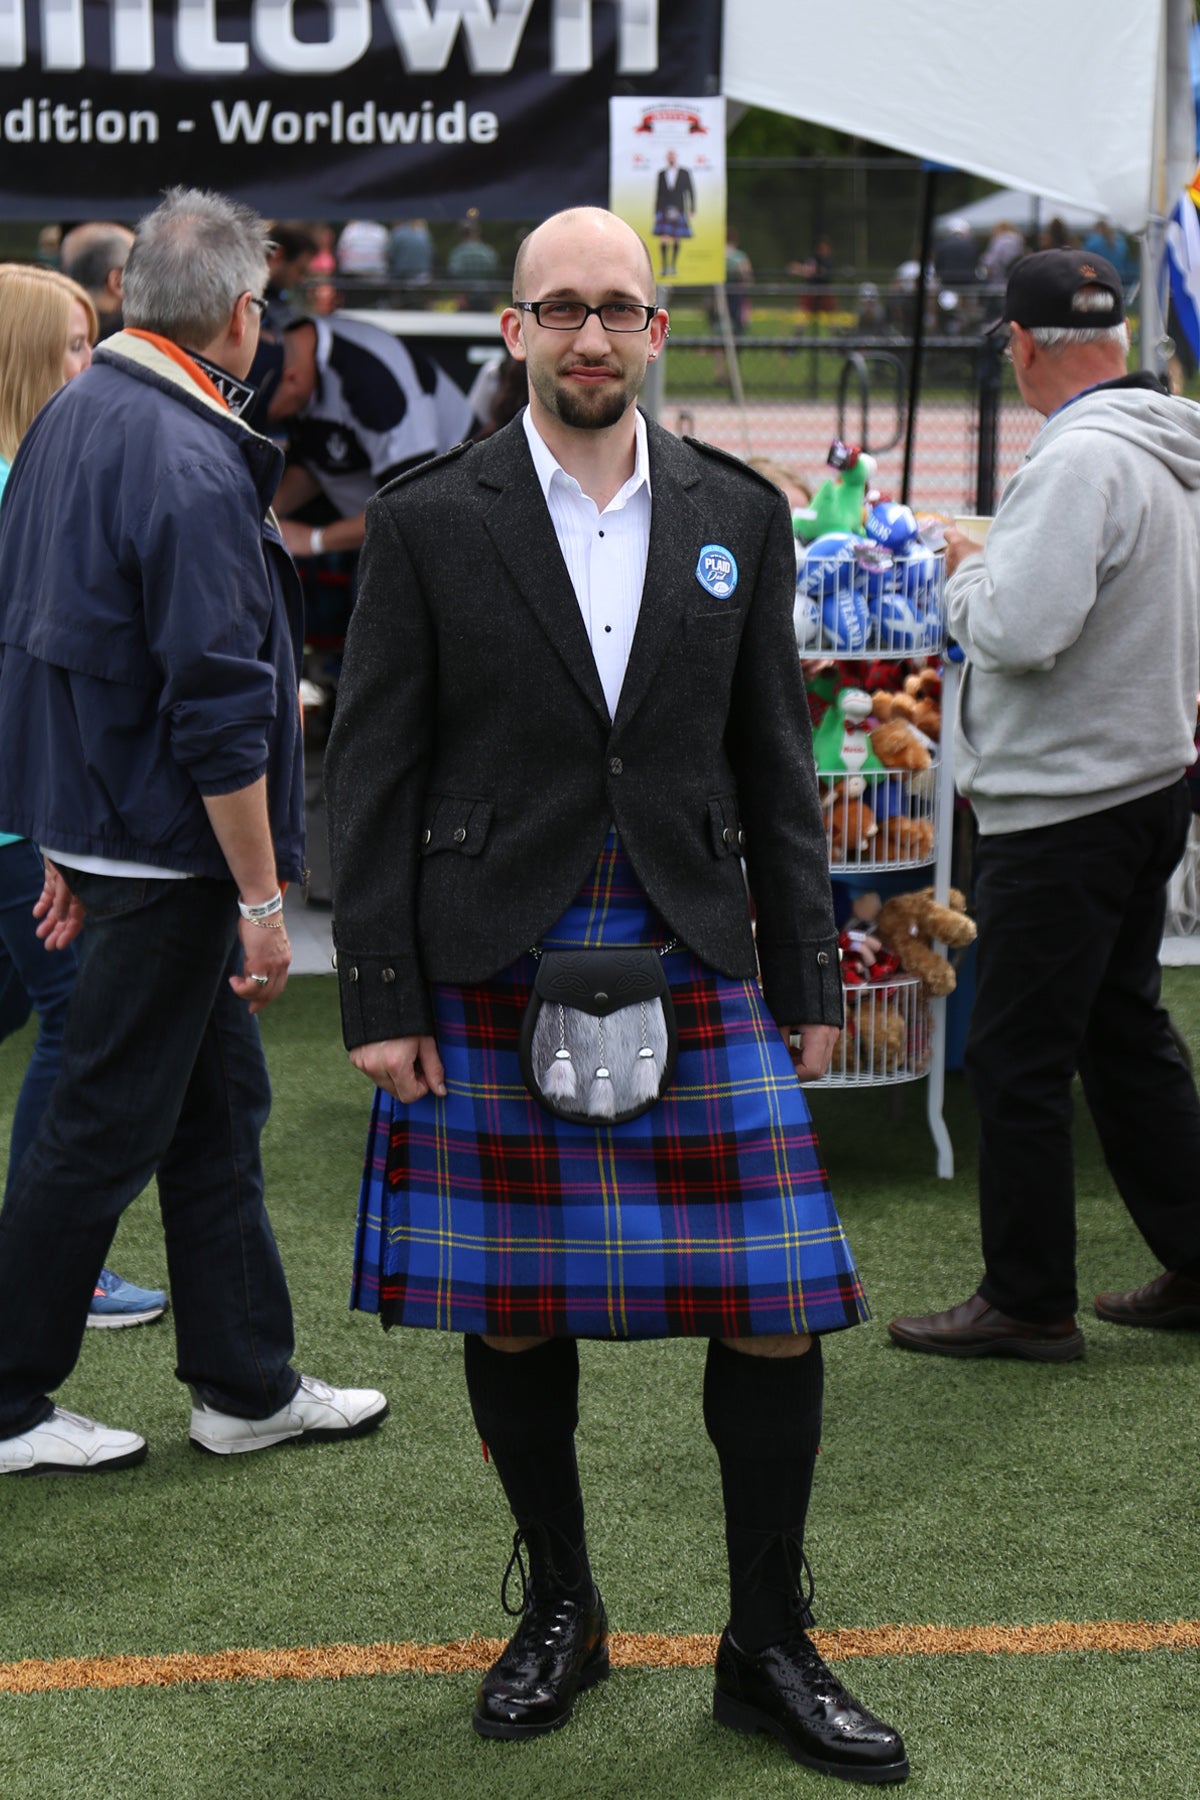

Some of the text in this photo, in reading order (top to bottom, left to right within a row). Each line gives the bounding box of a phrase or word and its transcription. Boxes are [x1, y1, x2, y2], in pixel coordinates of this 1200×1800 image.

[0, 99, 159, 143] dition
[210, 100, 499, 144] Worldwide
[705, 557, 731, 574] PLAID
